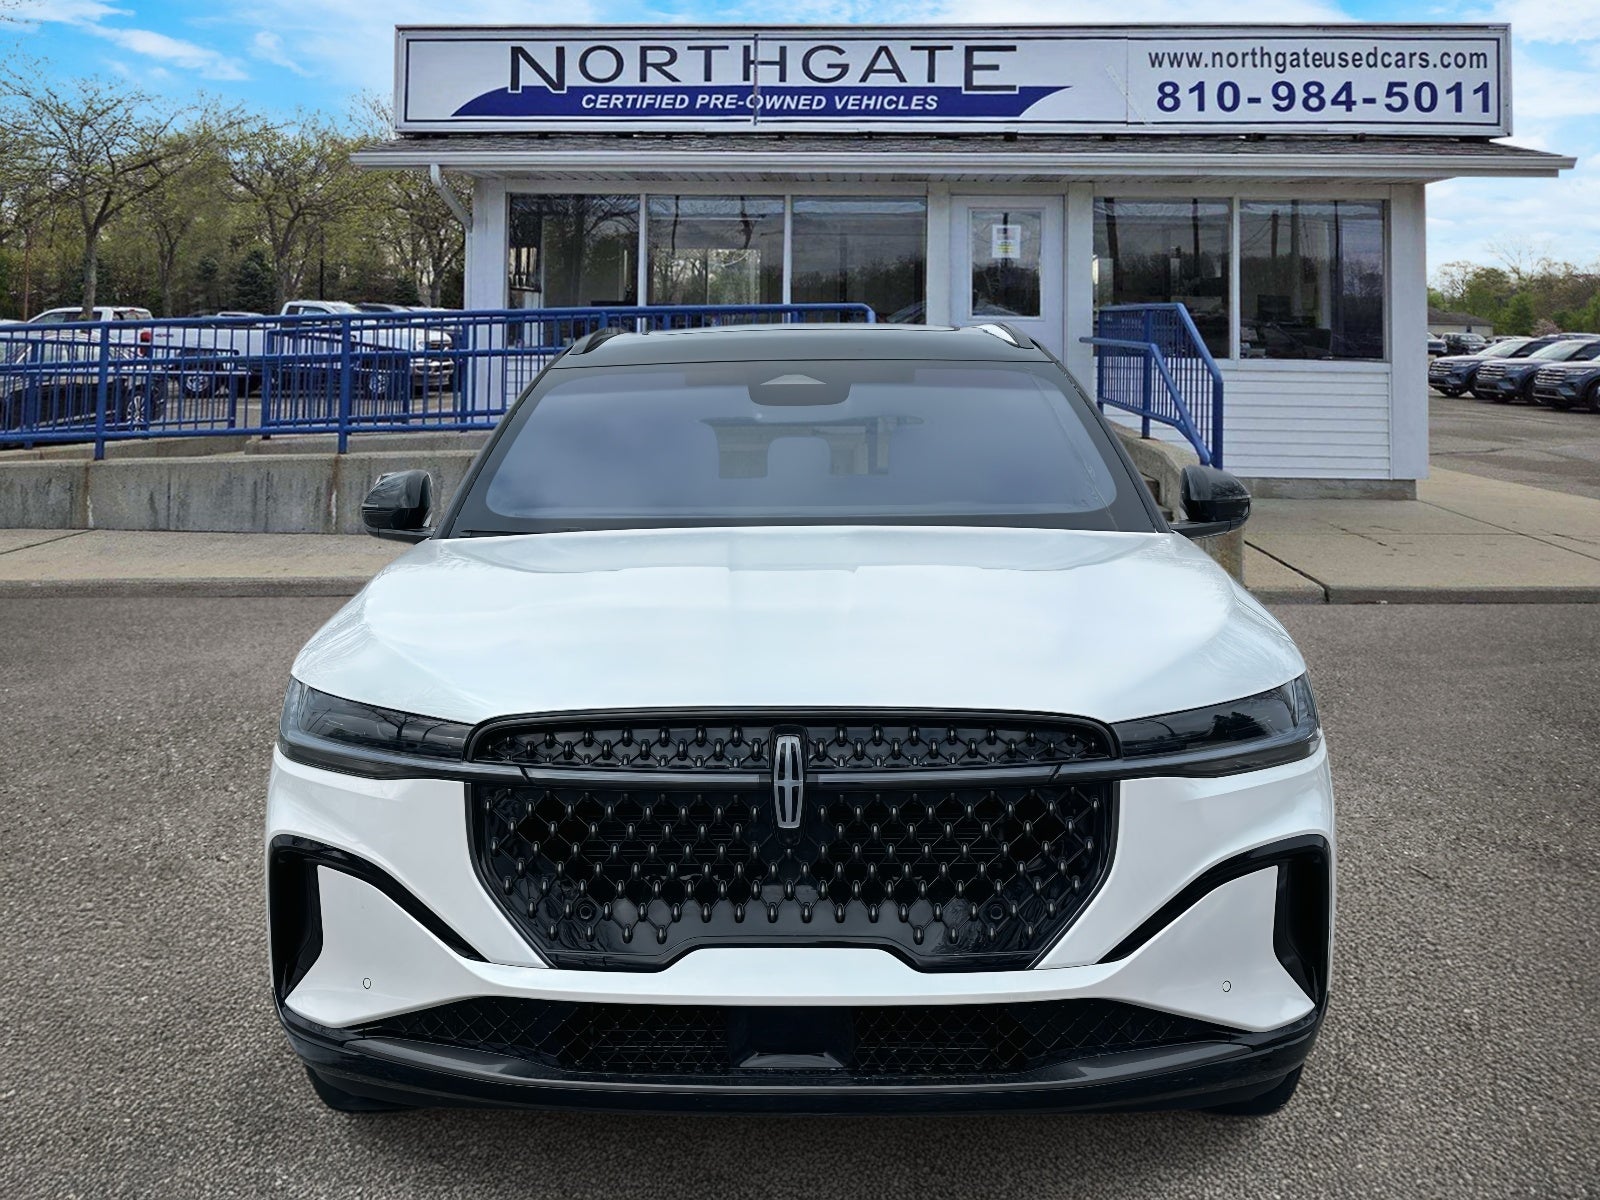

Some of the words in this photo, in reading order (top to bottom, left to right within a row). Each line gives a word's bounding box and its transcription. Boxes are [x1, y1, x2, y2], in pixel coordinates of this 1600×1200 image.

[509, 45, 1018, 93] NORTHGATE
[1149, 47, 1488, 73] www.northgateusedcars.com
[581, 94, 690, 109] CERTIFIED
[695, 94, 827, 110] PRE-OWNED
[834, 94, 938, 110] VEHICLES
[1156, 80, 1490, 113] 810-984-5011
